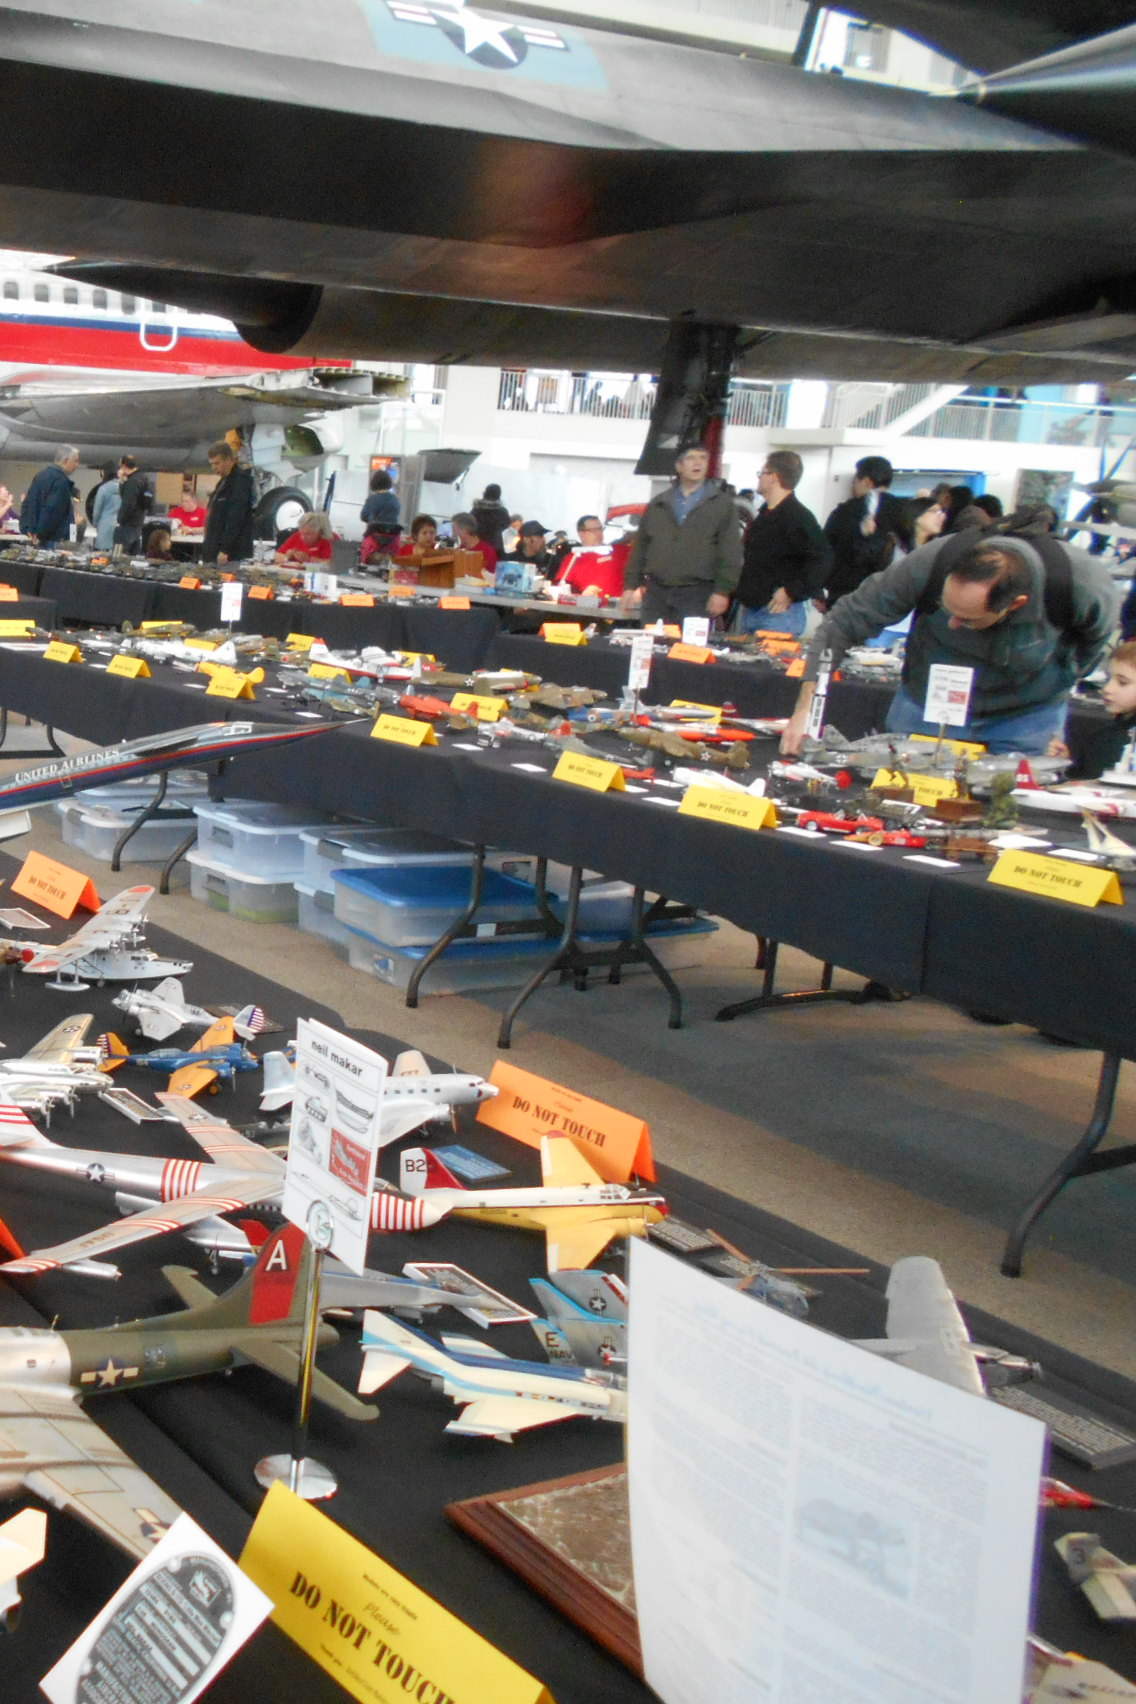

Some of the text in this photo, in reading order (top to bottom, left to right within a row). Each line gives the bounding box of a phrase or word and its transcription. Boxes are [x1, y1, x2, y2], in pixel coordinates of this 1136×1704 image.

[15, 764, 58, 783] UNITED
[1014, 865, 1083, 888] DO NOT TOUCH
[311, 1040, 364, 1077] neil makar
[512, 1095, 607, 1148] DO NOT TOUCH
[405, 1159, 427, 1172] B2
[265, 1239, 288, 1271] A
[289, 1571, 322, 1609] DO
[322, 1600, 372, 1650] NOT
[371, 1639, 457, 1704] TOUCH
